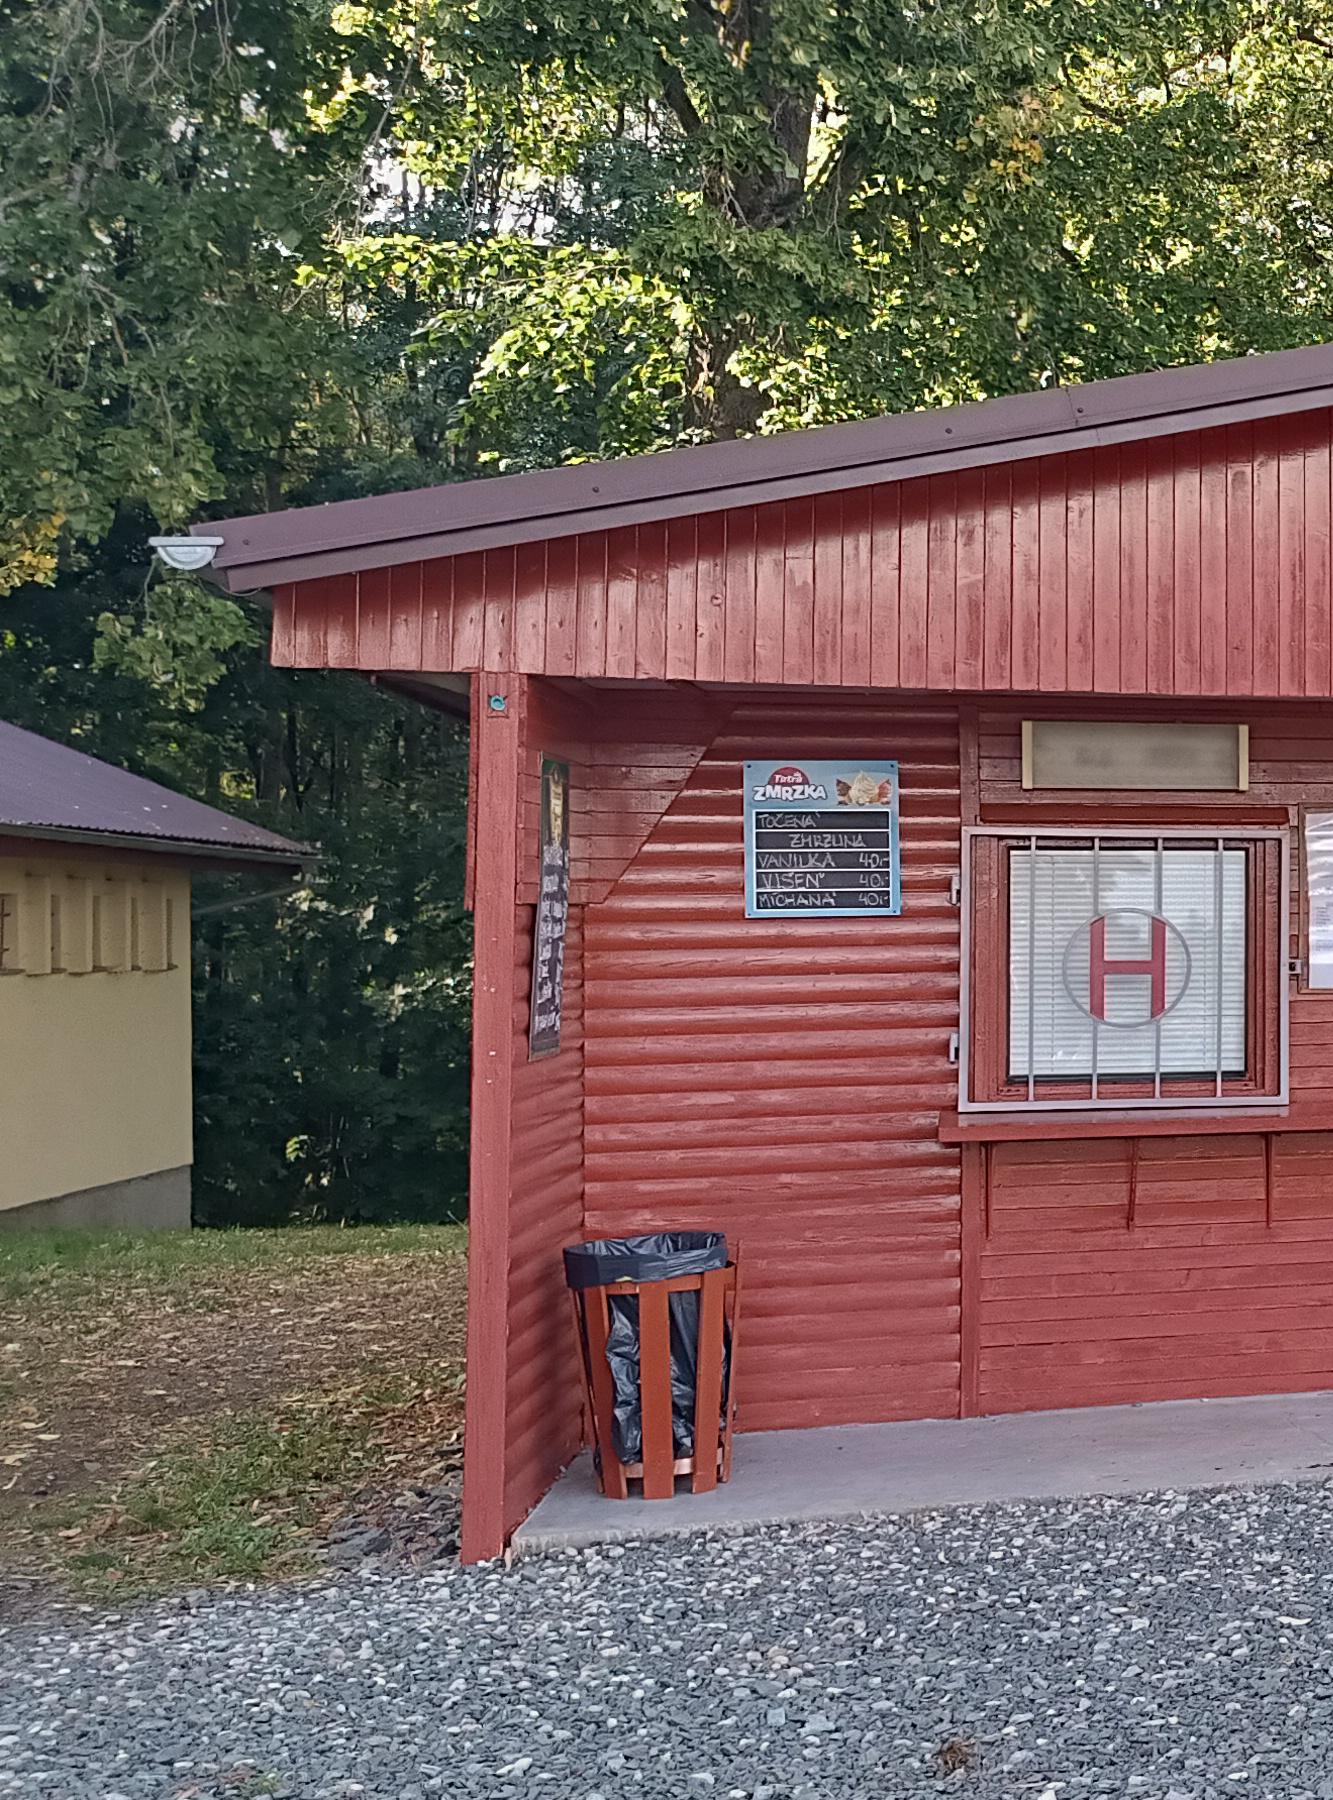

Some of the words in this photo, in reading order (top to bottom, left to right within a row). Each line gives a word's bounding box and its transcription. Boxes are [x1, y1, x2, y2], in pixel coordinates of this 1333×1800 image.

[753, 784, 828, 802] ZMRZKA
[757, 852, 836, 868] VANILKA
[1090, 915, 1166, 1021] H
